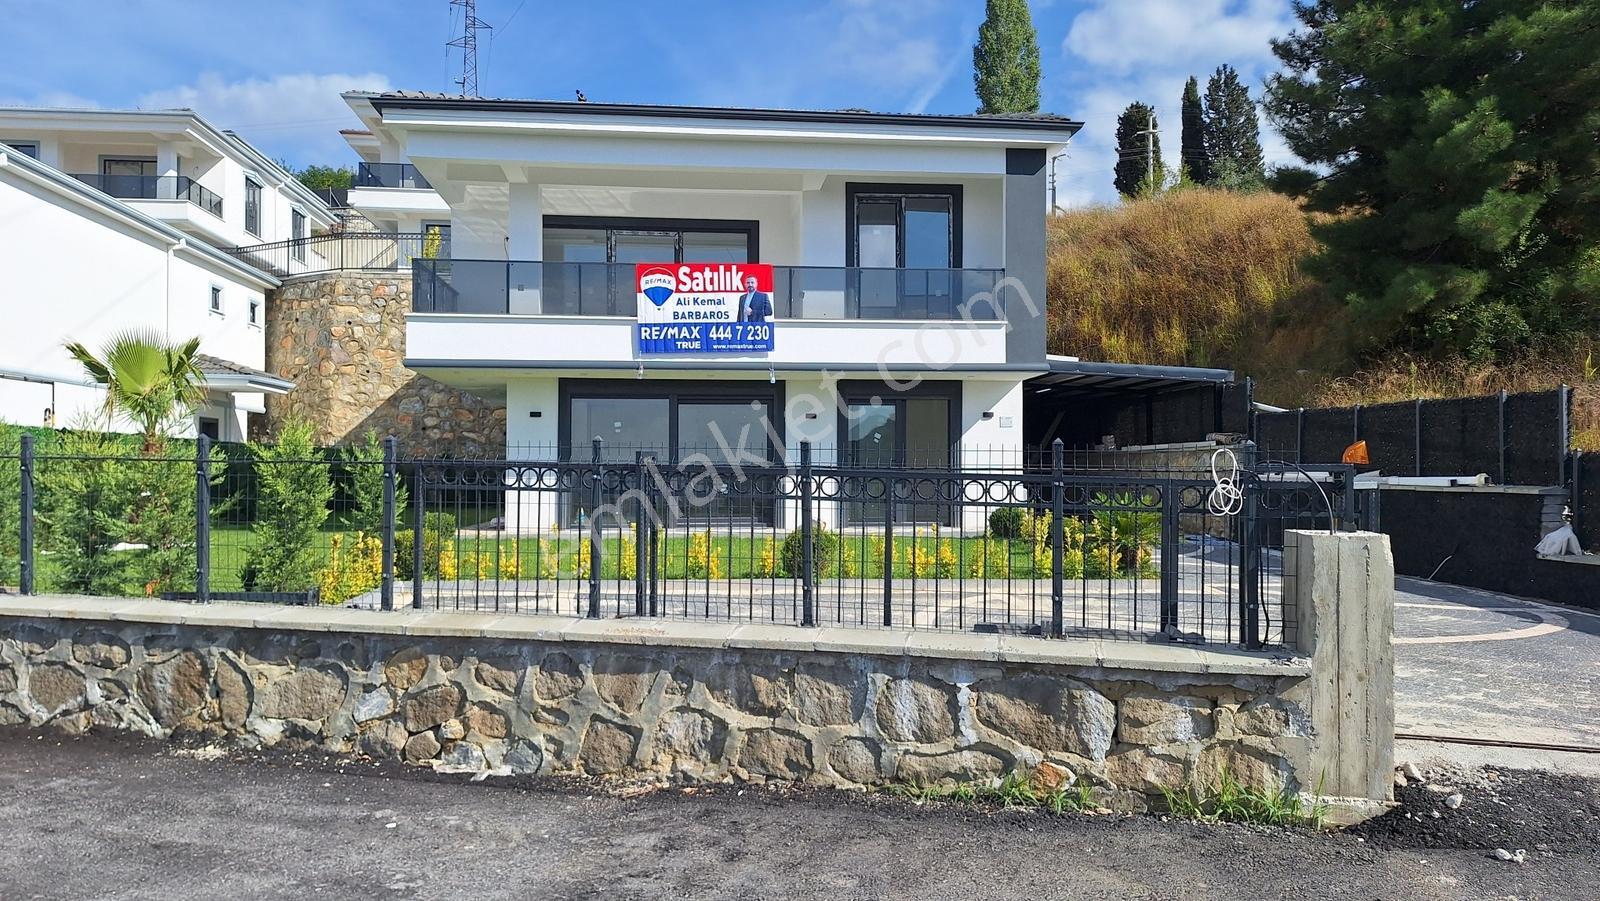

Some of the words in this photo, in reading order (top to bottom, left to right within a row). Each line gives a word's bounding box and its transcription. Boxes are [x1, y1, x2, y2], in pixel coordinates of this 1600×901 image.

[645, 278, 672, 286] RE/MAX
[678, 265, 745, 292] Satılık
[676, 297, 690, 306] Ali
[693, 297, 726, 306] Kemal
[673, 311, 730, 320] BARBAROS
[641, 326, 702, 340] RE/MAX
[709, 325, 733, 341] 444
[736, 325, 744, 340] 7
[747, 325, 770, 341] 230
[676, 341, 701, 349] TRUE
